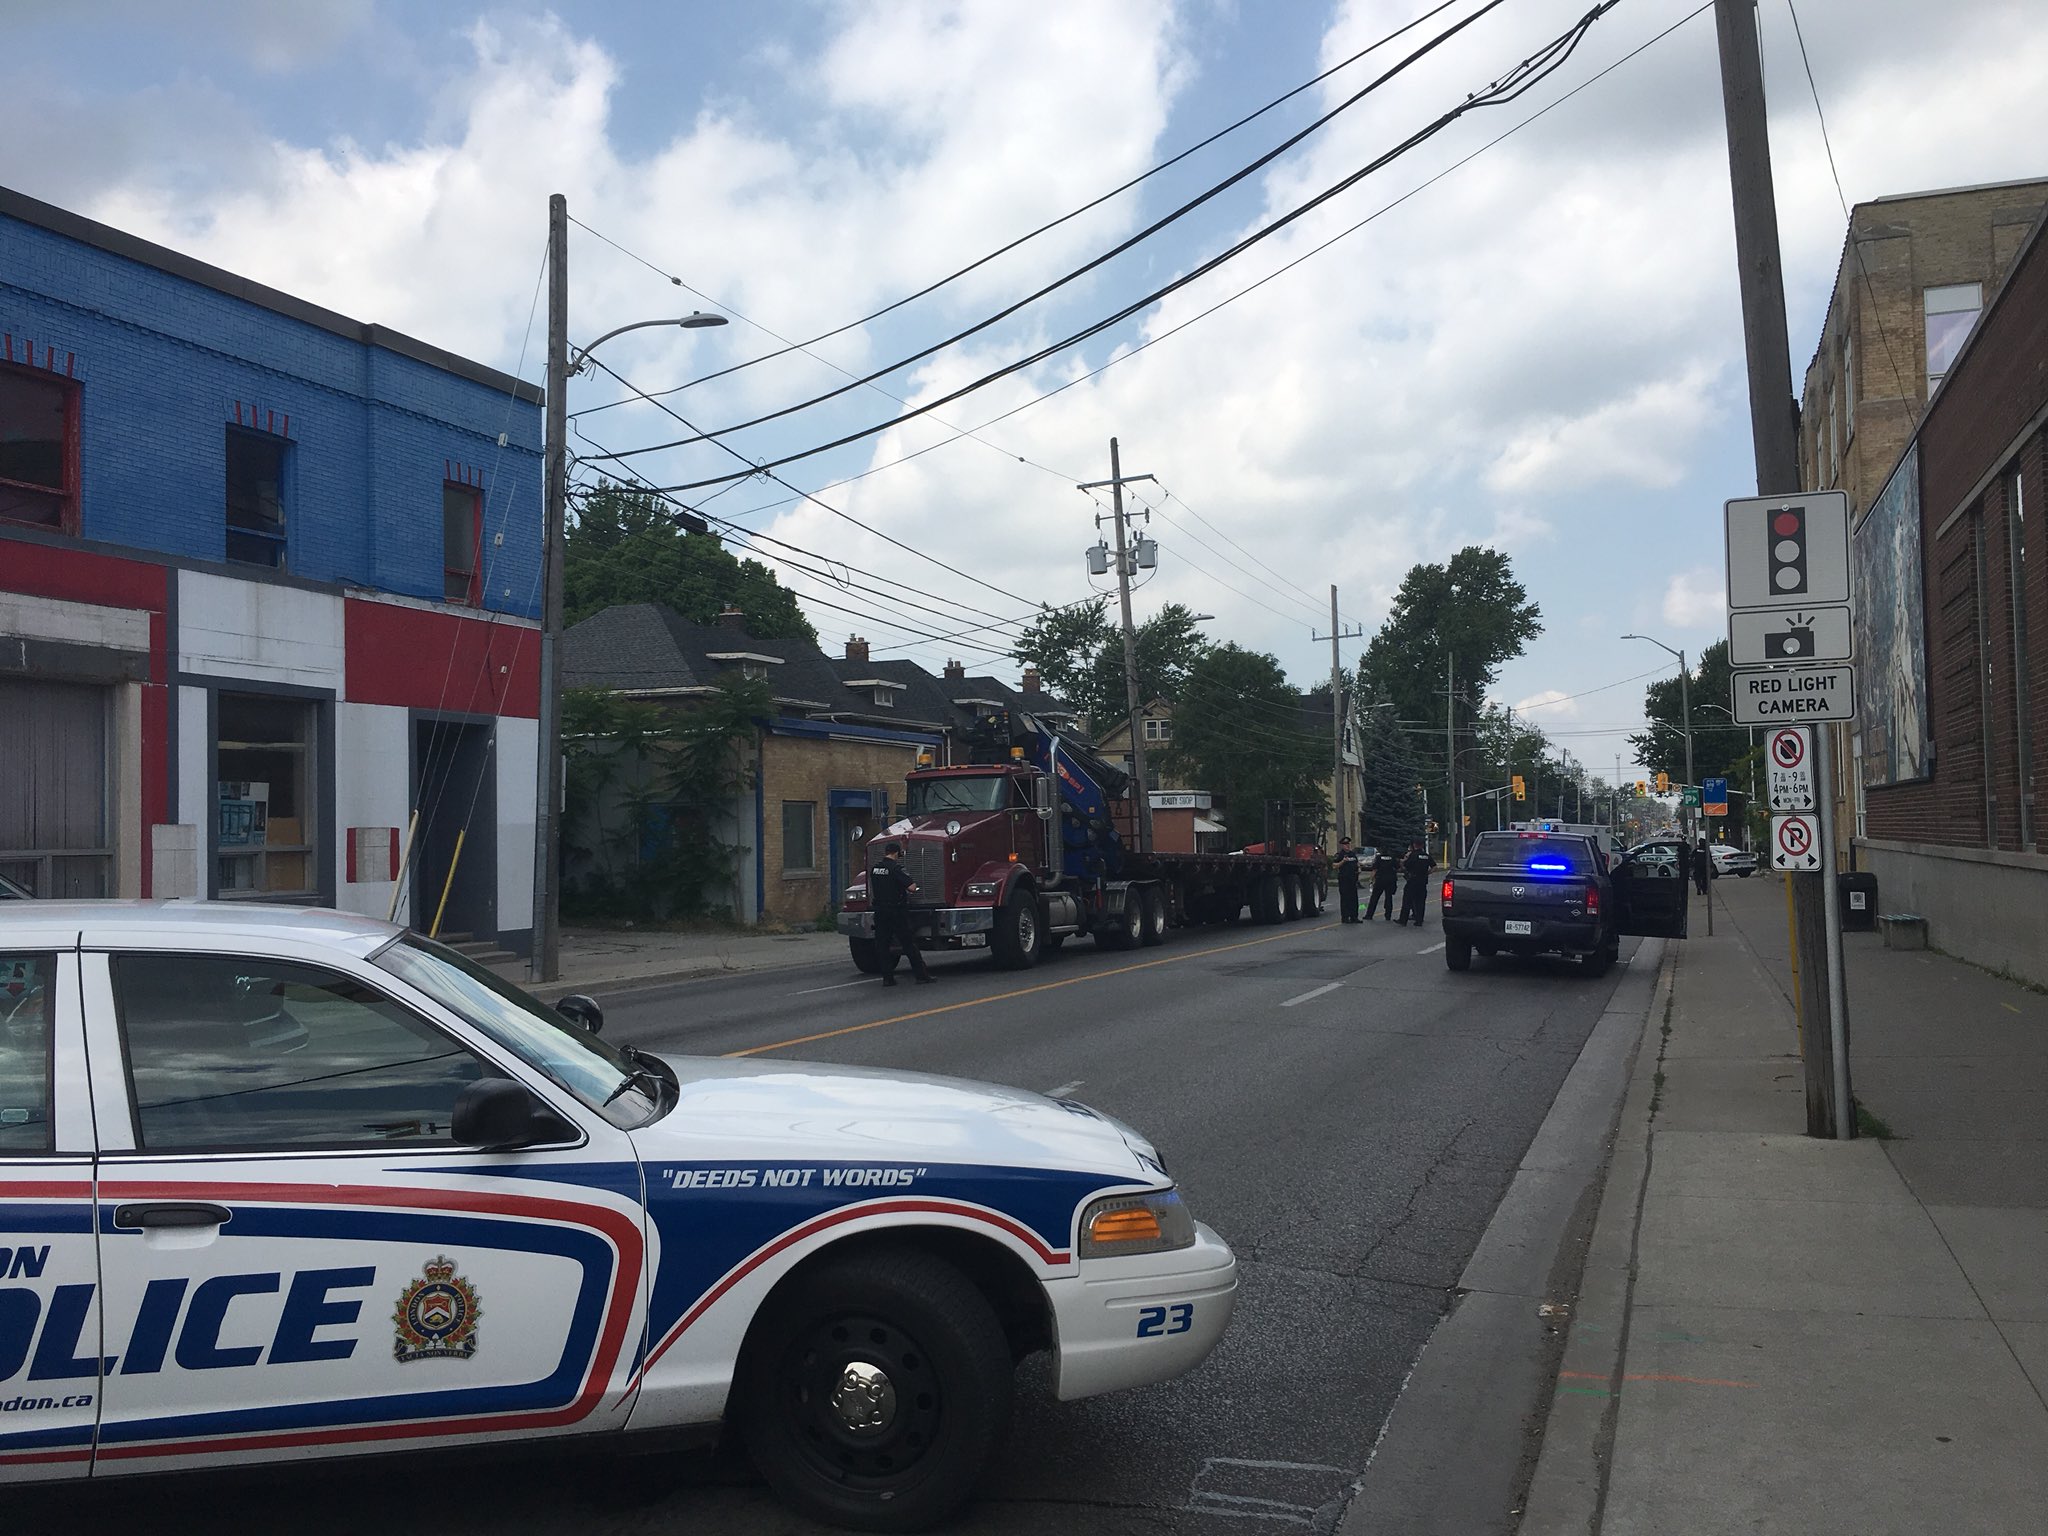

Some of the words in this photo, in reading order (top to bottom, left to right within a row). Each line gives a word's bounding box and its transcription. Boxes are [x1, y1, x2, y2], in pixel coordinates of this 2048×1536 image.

[1749, 680, 1782, 694] RED
[1788, 675, 1837, 692] LIGHT
[1758, 697, 1830, 714] CAMERA
[873, 867, 886, 875] POLICE
[761, 1168, 816, 1187] NOT
[1136, 1303, 1194, 1338] 23
[0, 1395, 93, 1412] don.ca
